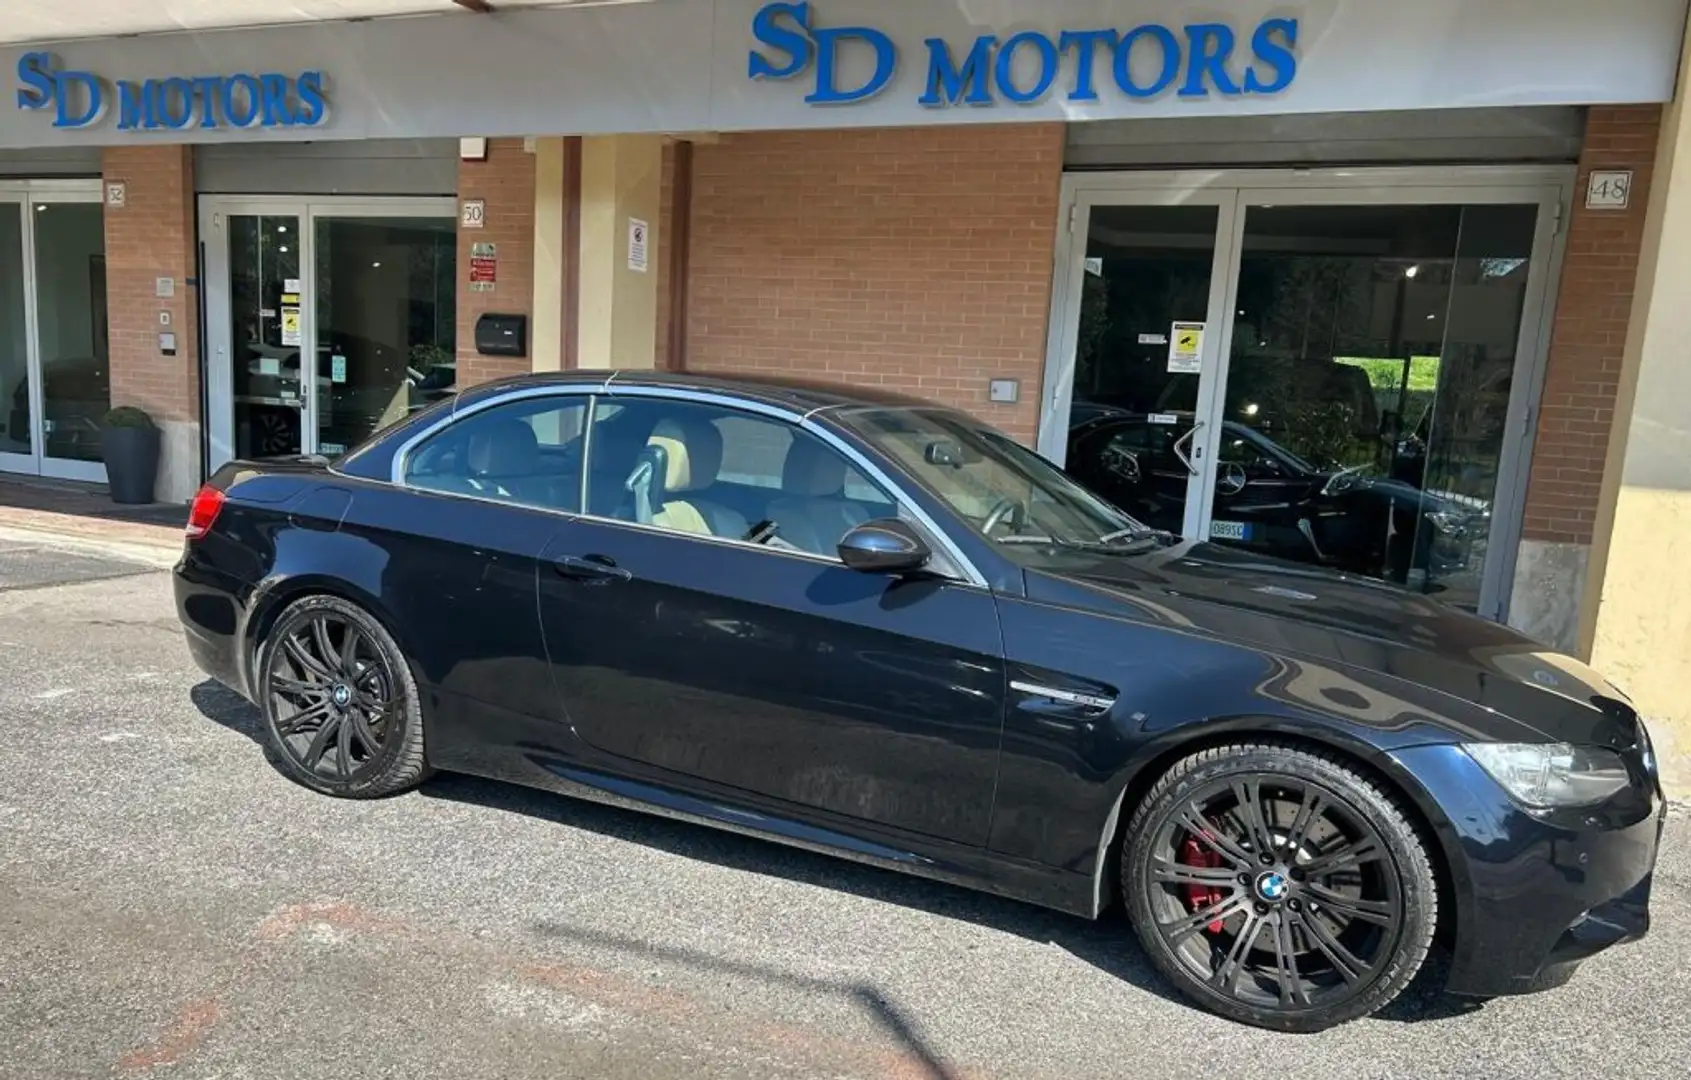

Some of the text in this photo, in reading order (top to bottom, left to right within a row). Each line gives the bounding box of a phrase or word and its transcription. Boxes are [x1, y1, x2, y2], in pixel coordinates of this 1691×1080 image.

[748, 2, 1299, 106] SD MOTORS
[17, 52, 325, 130] SD MOTORS
[463, 205, 482, 221] 50
[1591, 178, 1625, 199] 48
